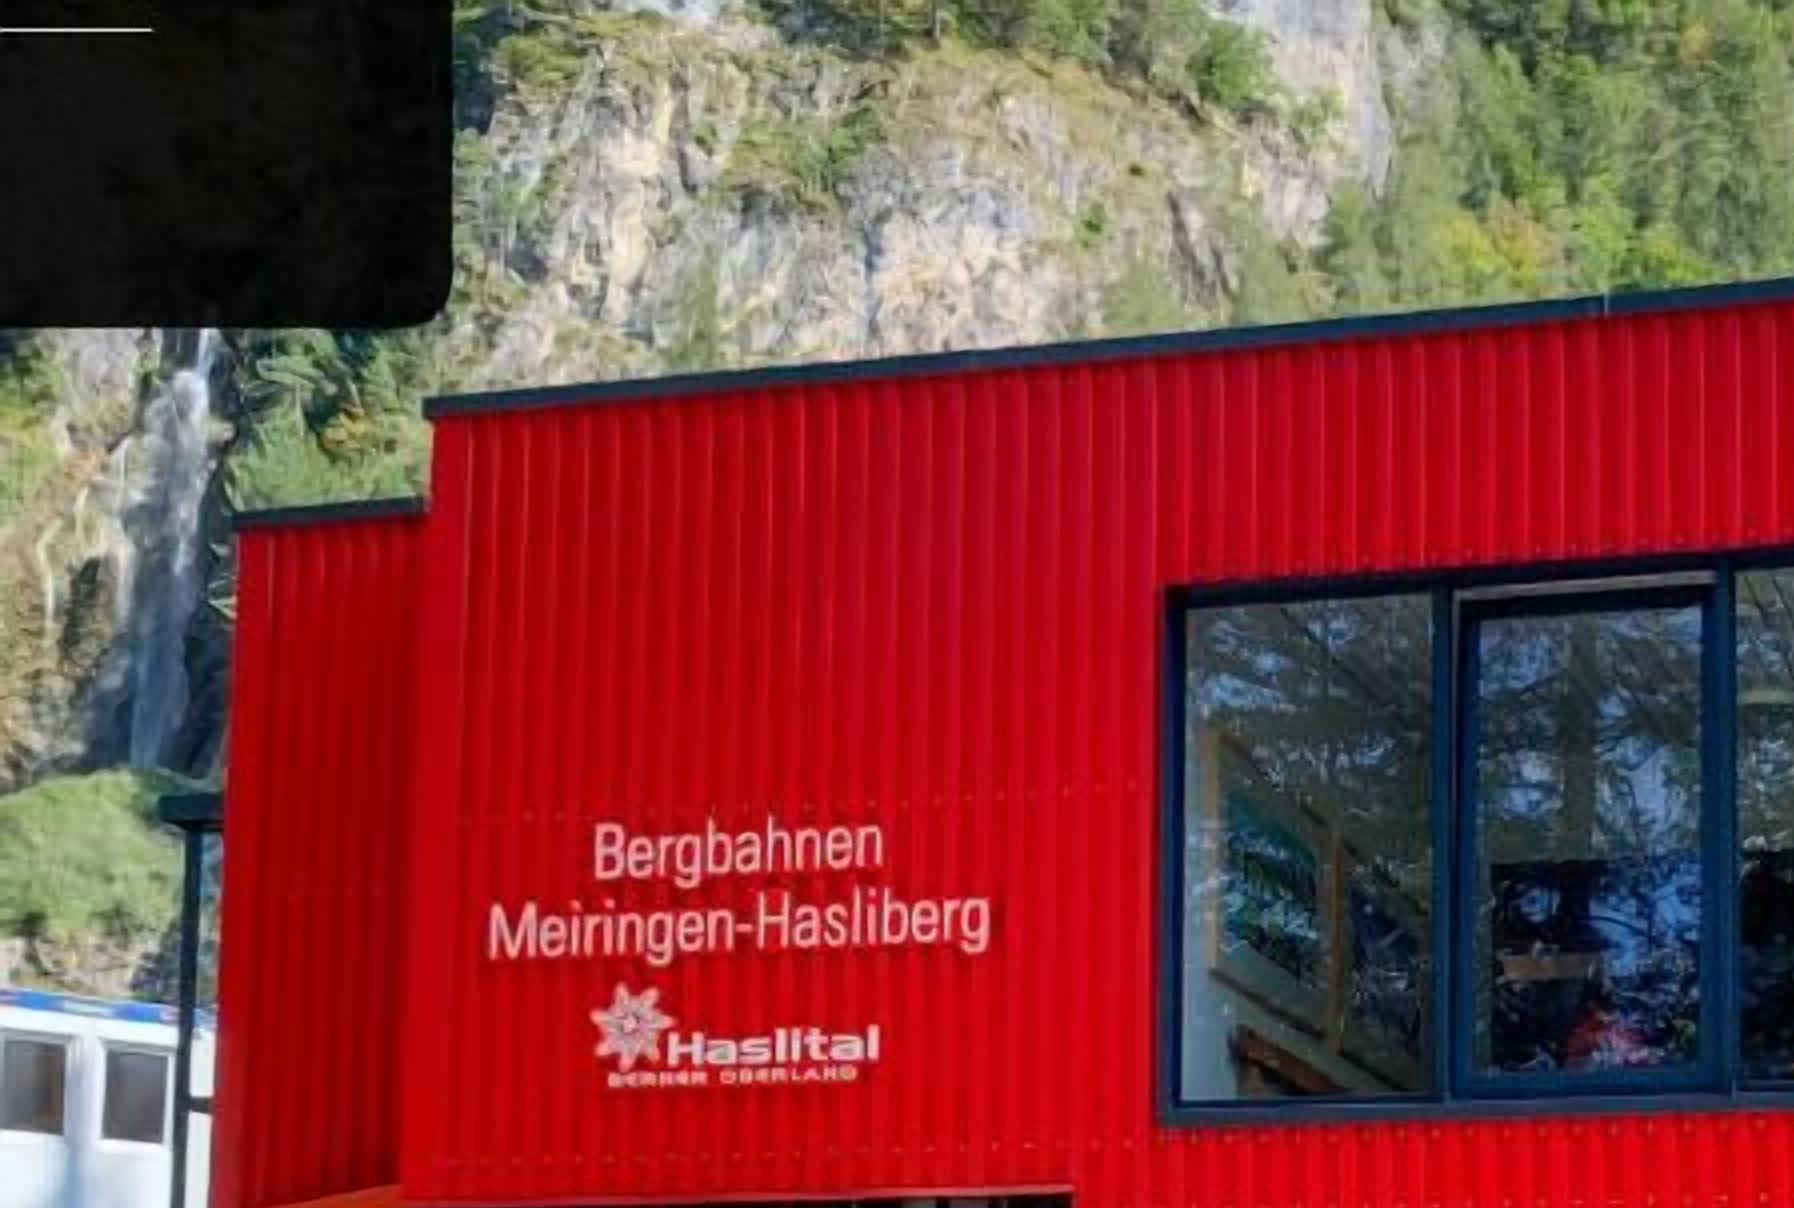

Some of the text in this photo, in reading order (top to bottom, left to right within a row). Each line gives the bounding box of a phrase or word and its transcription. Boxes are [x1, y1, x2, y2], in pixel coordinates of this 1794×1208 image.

[594, 815, 883, 889] Bergbahnen
[488, 889, 991, 967] Meiringen-Hasliberg
[667, 1024, 880, 1066] Haslital
[608, 1066, 858, 1088] BERNER OBERLAND
